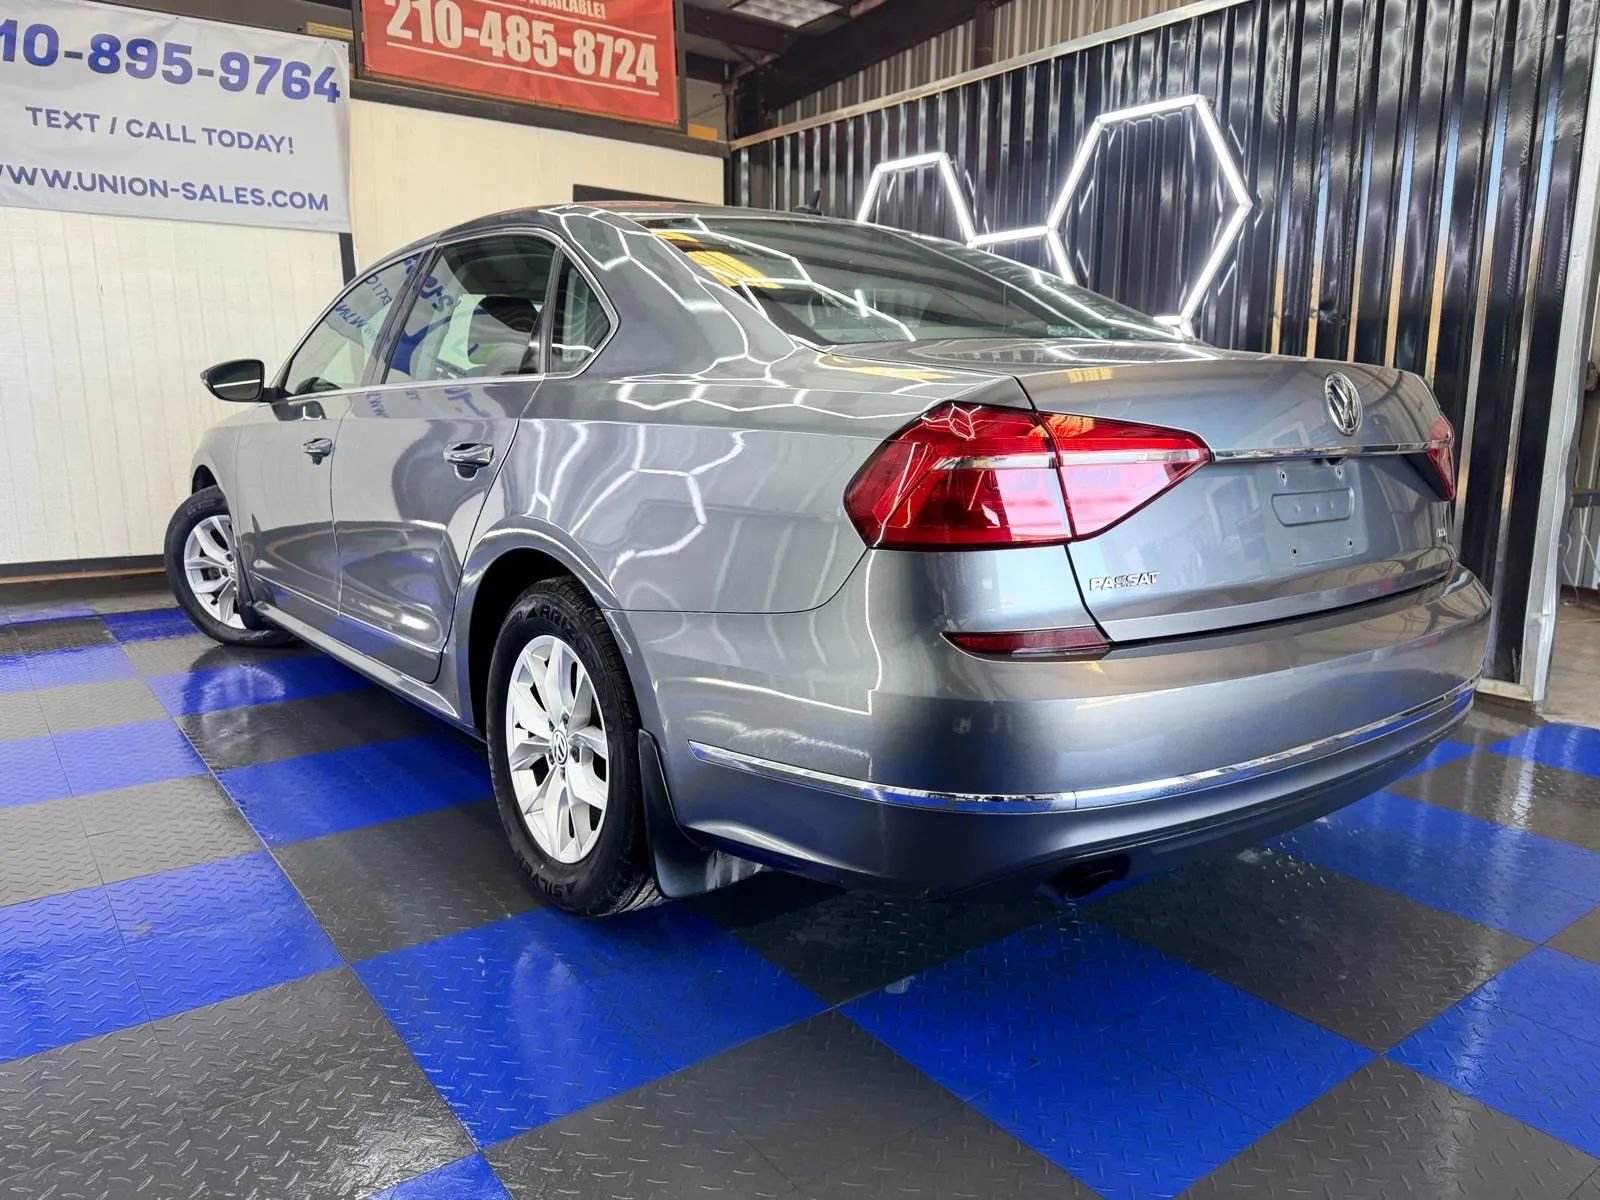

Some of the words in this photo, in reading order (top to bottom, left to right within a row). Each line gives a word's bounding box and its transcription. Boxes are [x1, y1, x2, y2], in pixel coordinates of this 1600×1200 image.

[528, 0, 606, 19] AILABLE!
[0, 18, 341, 104] 10-895-9764
[384, 0, 659, 86] 210-485-8724
[25, 106, 101, 133] TEXT
[126, 118, 197, 145] CALL
[202, 127, 295, 155] TODAY!
[0, 164, 329, 212] WW.UNION-SALES.COM
[1089, 570, 1160, 592] PASSAT
